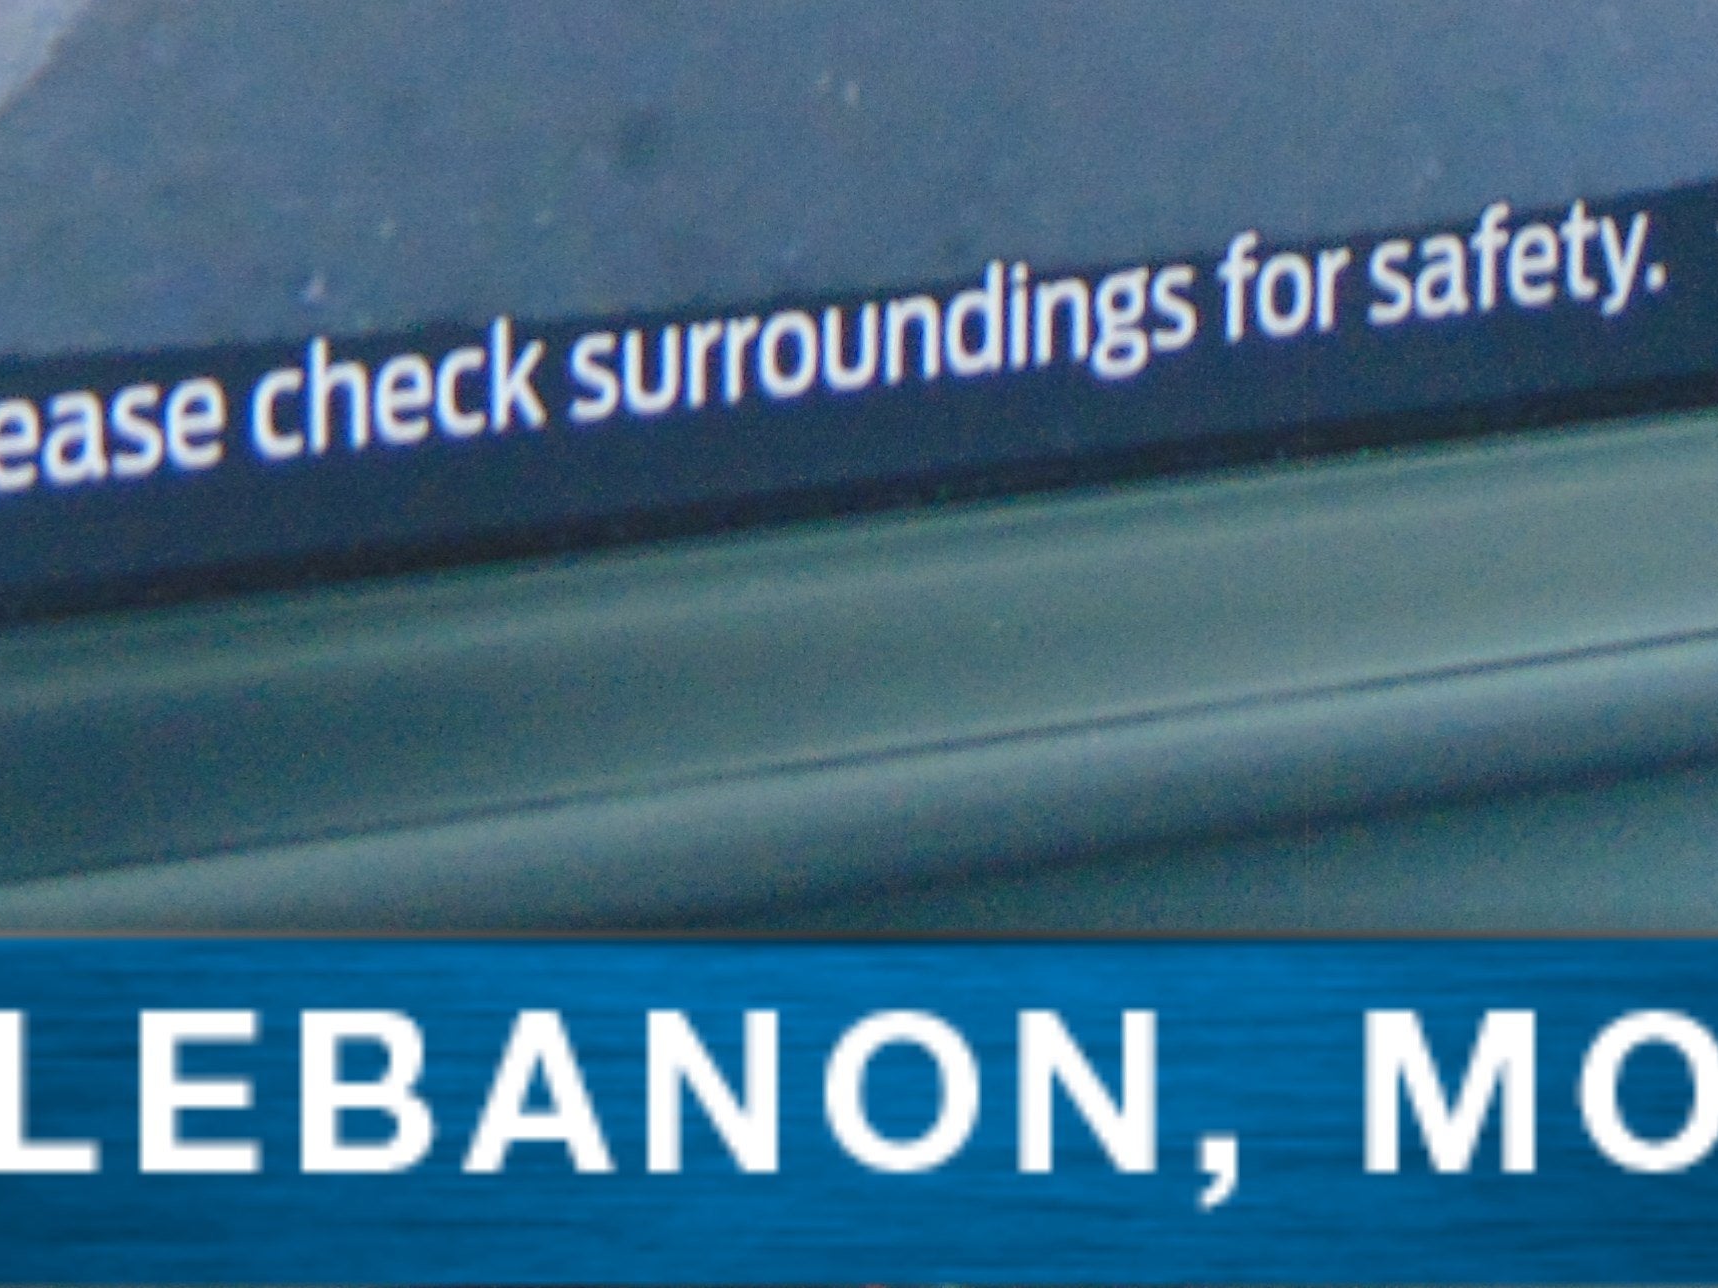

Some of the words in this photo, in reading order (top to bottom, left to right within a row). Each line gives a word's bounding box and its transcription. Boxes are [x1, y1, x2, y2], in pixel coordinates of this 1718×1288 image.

[254, 315, 546, 459] check
[572, 259, 1198, 421] surroundings
[1219, 229, 1351, 342] for
[1370, 199, 1666, 325] safety.
